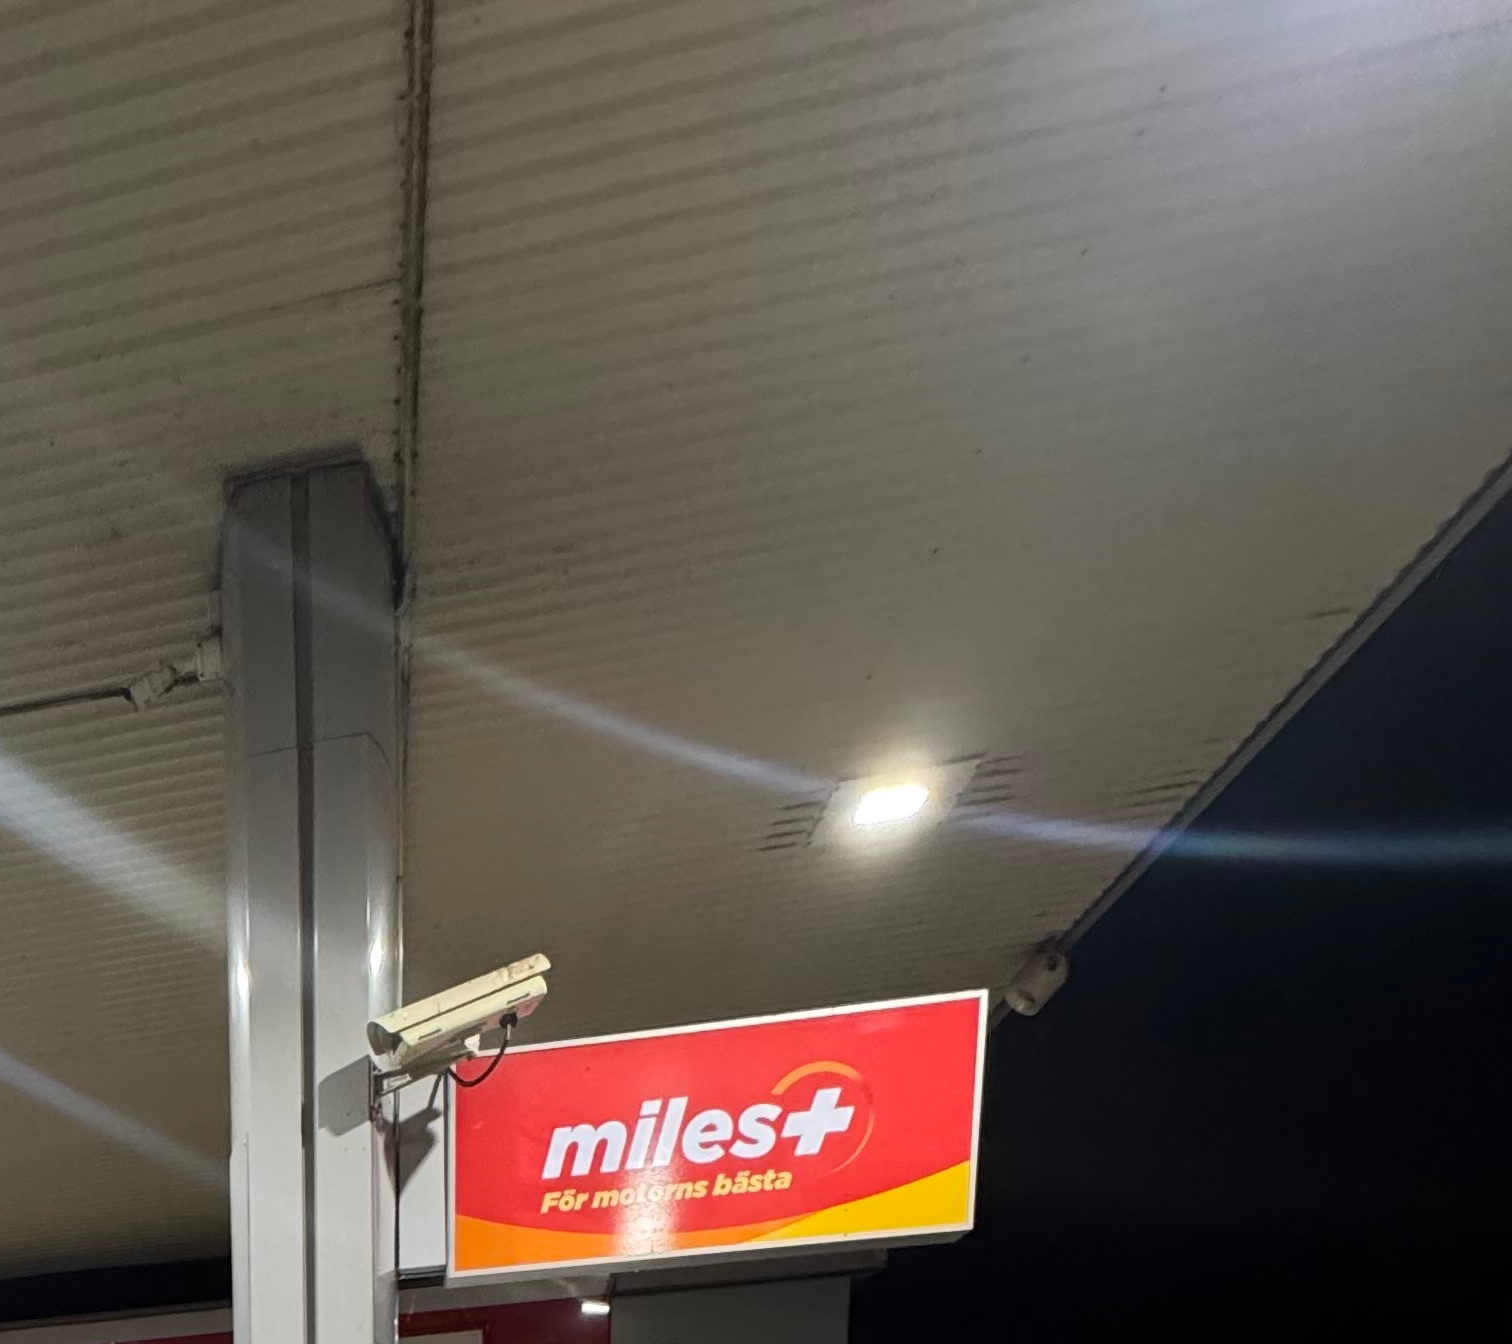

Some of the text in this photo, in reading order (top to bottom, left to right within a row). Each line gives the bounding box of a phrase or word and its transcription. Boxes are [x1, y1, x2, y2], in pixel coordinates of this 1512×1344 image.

[541, 1087, 854, 1180] miles+
[540, 1169, 793, 1214] För motorns bästa
